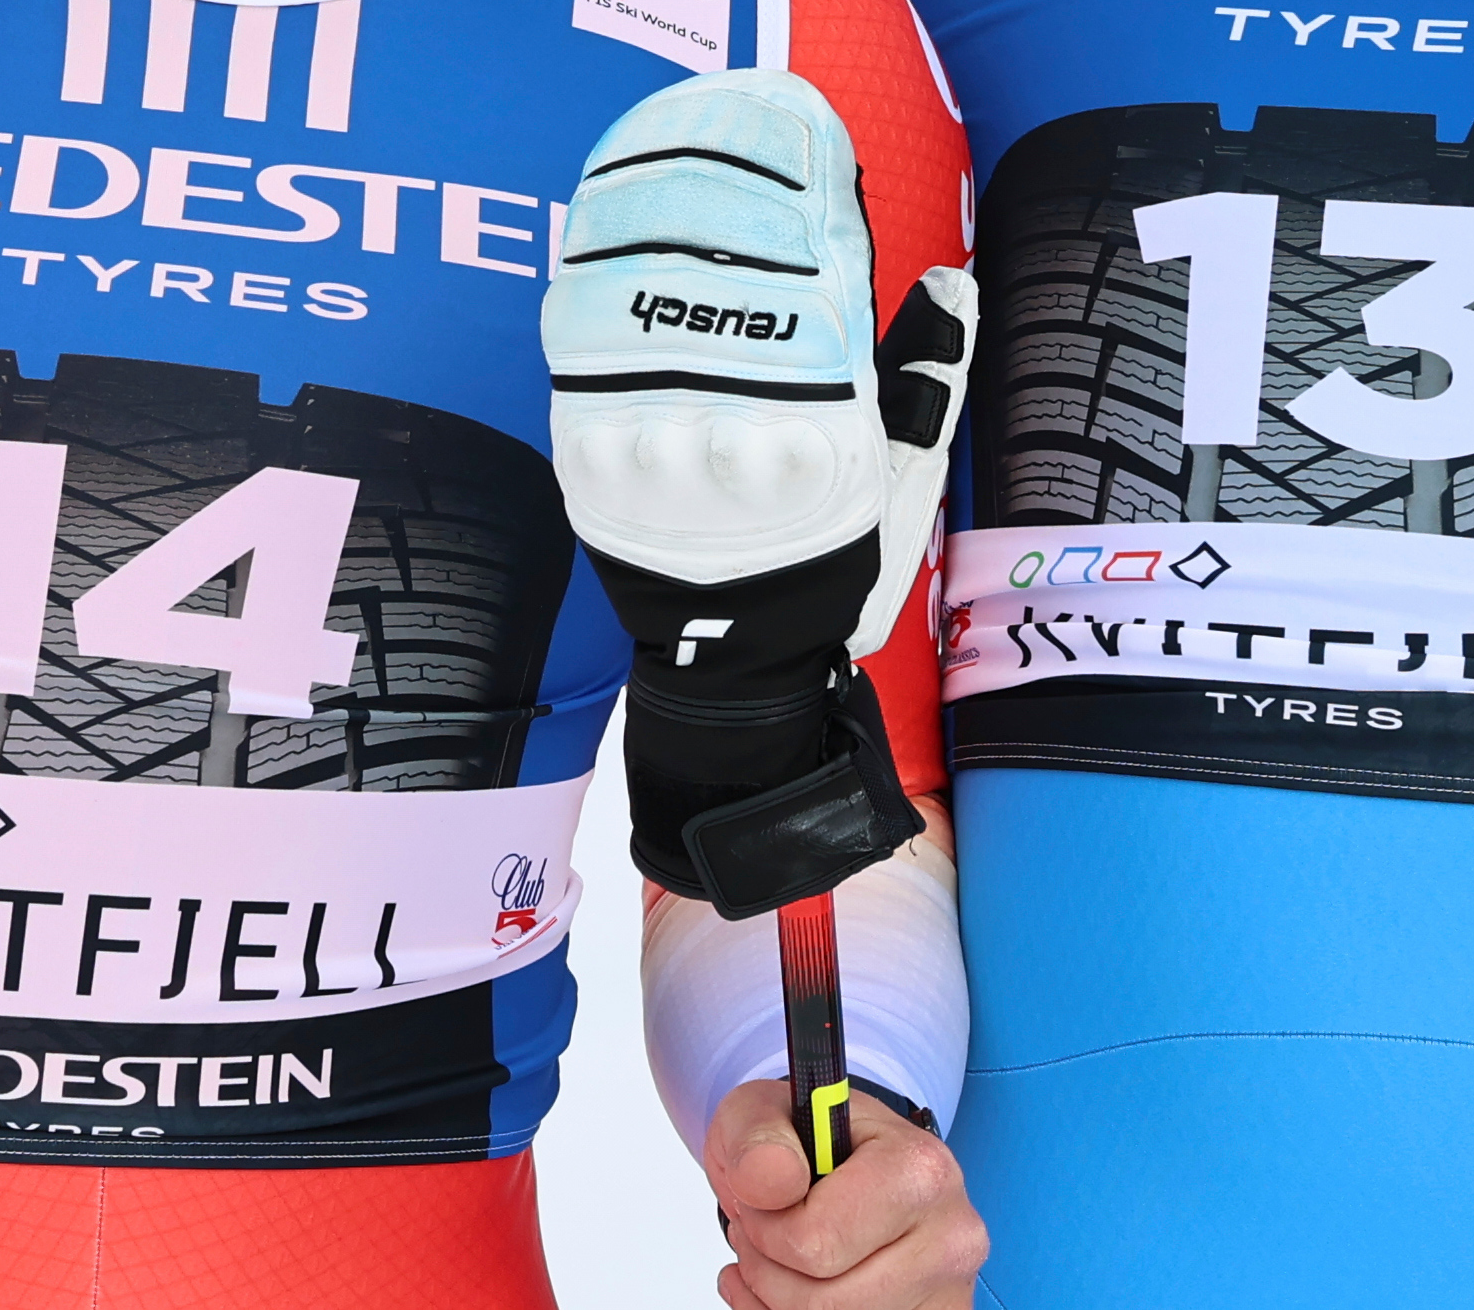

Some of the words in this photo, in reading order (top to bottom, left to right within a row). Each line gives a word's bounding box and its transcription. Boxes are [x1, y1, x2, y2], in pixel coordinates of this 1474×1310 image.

[616, 2, 638, 18] Ski
[641, 10, 686, 38] World
[690, 31, 718, 51] Cup
[3, 246, 370, 322] TYRES
[631, 290, 798, 341] reusch
[1205, 692, 1403, 730] TYRES
[492, 853, 546, 913] Club
